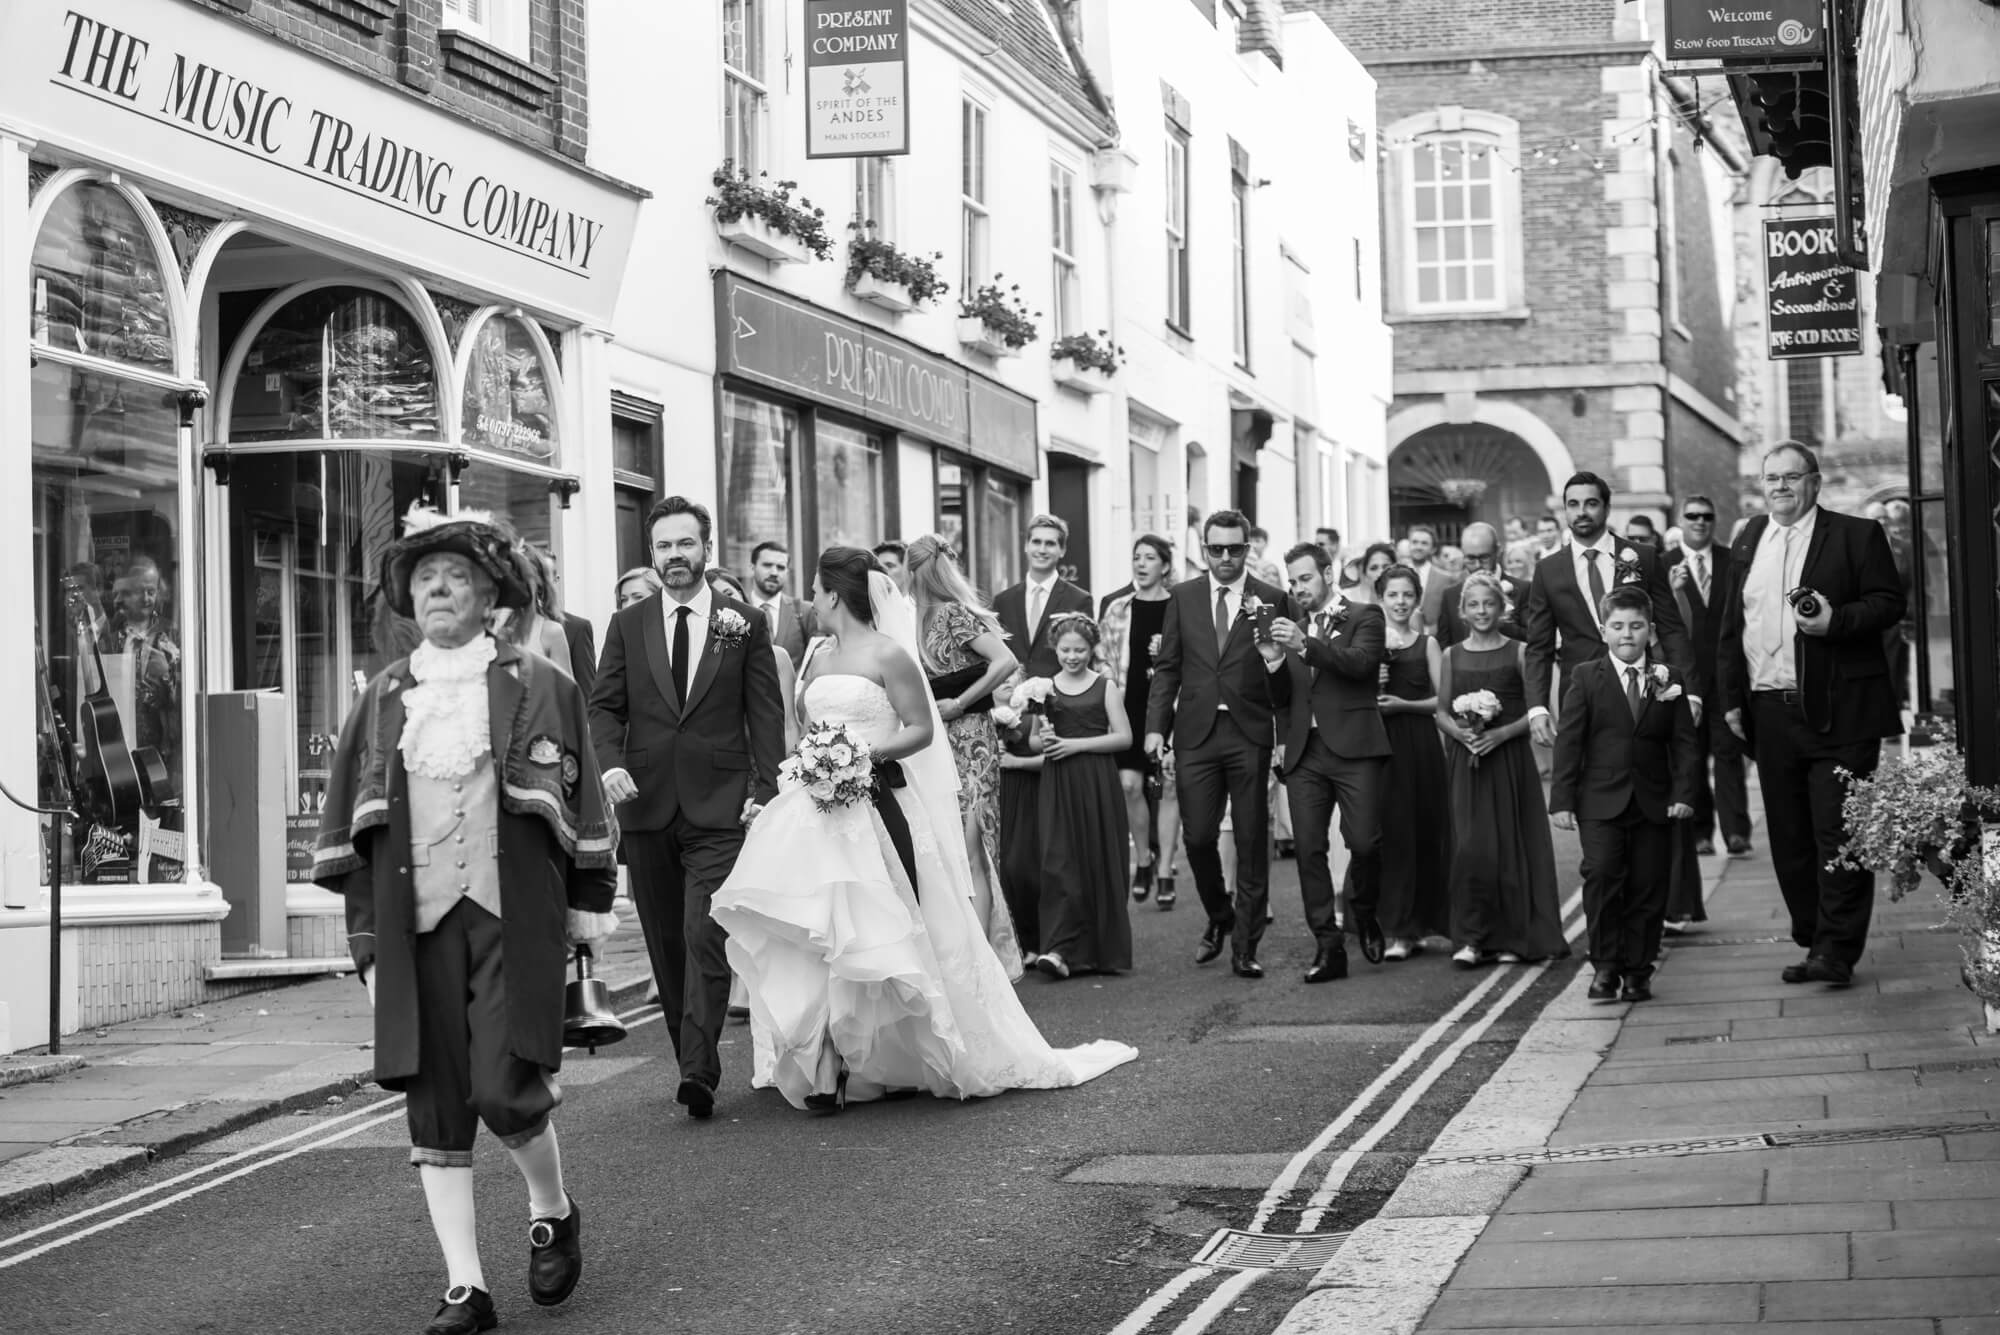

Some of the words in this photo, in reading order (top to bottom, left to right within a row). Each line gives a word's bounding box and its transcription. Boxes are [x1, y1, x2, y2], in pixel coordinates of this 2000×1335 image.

[817, 9, 893, 28] PRESENT
[813, 33, 898, 54] COMPANY
[816, 99, 851, 110] SPIRIT
[856, 97, 871, 108] OF
[876, 96, 897, 106] THE
[830, 109, 884, 124] ANDES
[58, 10, 150, 101] THE
[159, 52, 293, 154] MUSIC
[304, 109, 454, 215] TRADING
[463, 175, 603, 269] COMPANY
[824, 132, 848, 141] MAIN
[851, 130, 891, 141] STOCKIST
[1767, 227, 1838, 257] BOOK
[1823, 278, 1845, 298] &
[1771, 297, 1857, 316] Secondhand
[1795, 329, 1820, 345] OLD
[1821, 328, 1860, 343] BOOKS
[824, 331, 903, 410] PRESENT
[1059, 565, 1079, 581] 22
